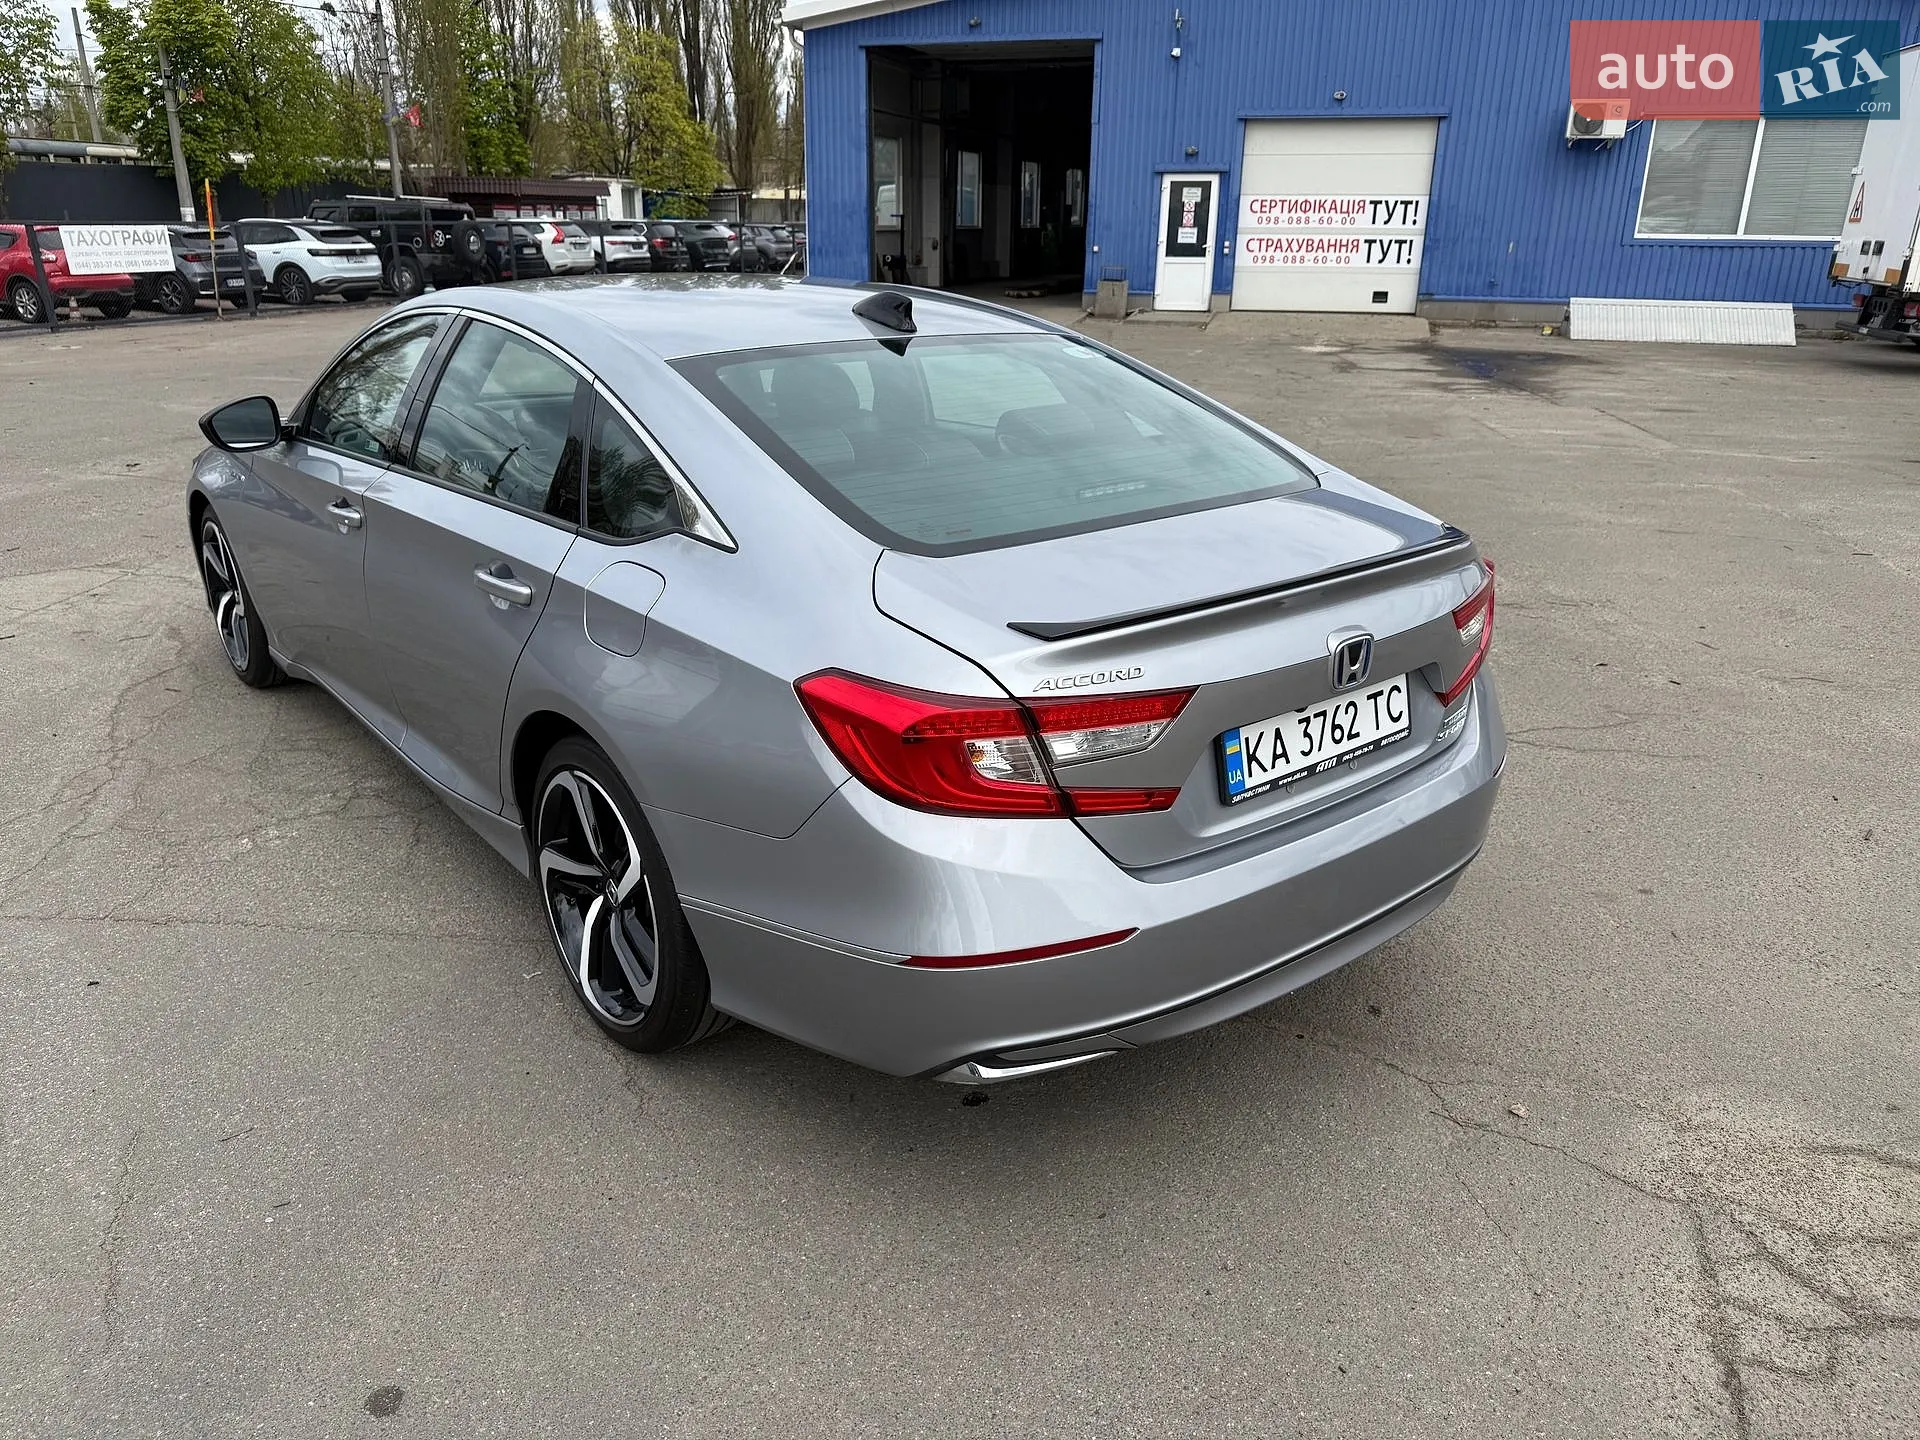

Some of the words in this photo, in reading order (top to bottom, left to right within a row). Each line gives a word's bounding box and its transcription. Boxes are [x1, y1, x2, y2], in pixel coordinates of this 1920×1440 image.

[1249, 198, 1366, 217] СЕРТИФІКАЦІЯ
[1369, 200, 1420, 226] ТУТ!
[1257, 216, 1356, 226] 098-088-60-00
[63, 229, 168, 247] ТАХОГРАФИ
[1245, 238, 1360, 254] СТРАХУВАННЯ
[1363, 239, 1414, 265] ТУТ!
[1252, 255, 1351, 265] 098-088-60-00
[1032, 665, 1145, 693] ACCORD
[1245, 727, 1291, 778] KA
[1297, 700, 1360, 757] 3762
[1366, 684, 1404, 731] TC
[1228, 769, 1244, 785] UA
